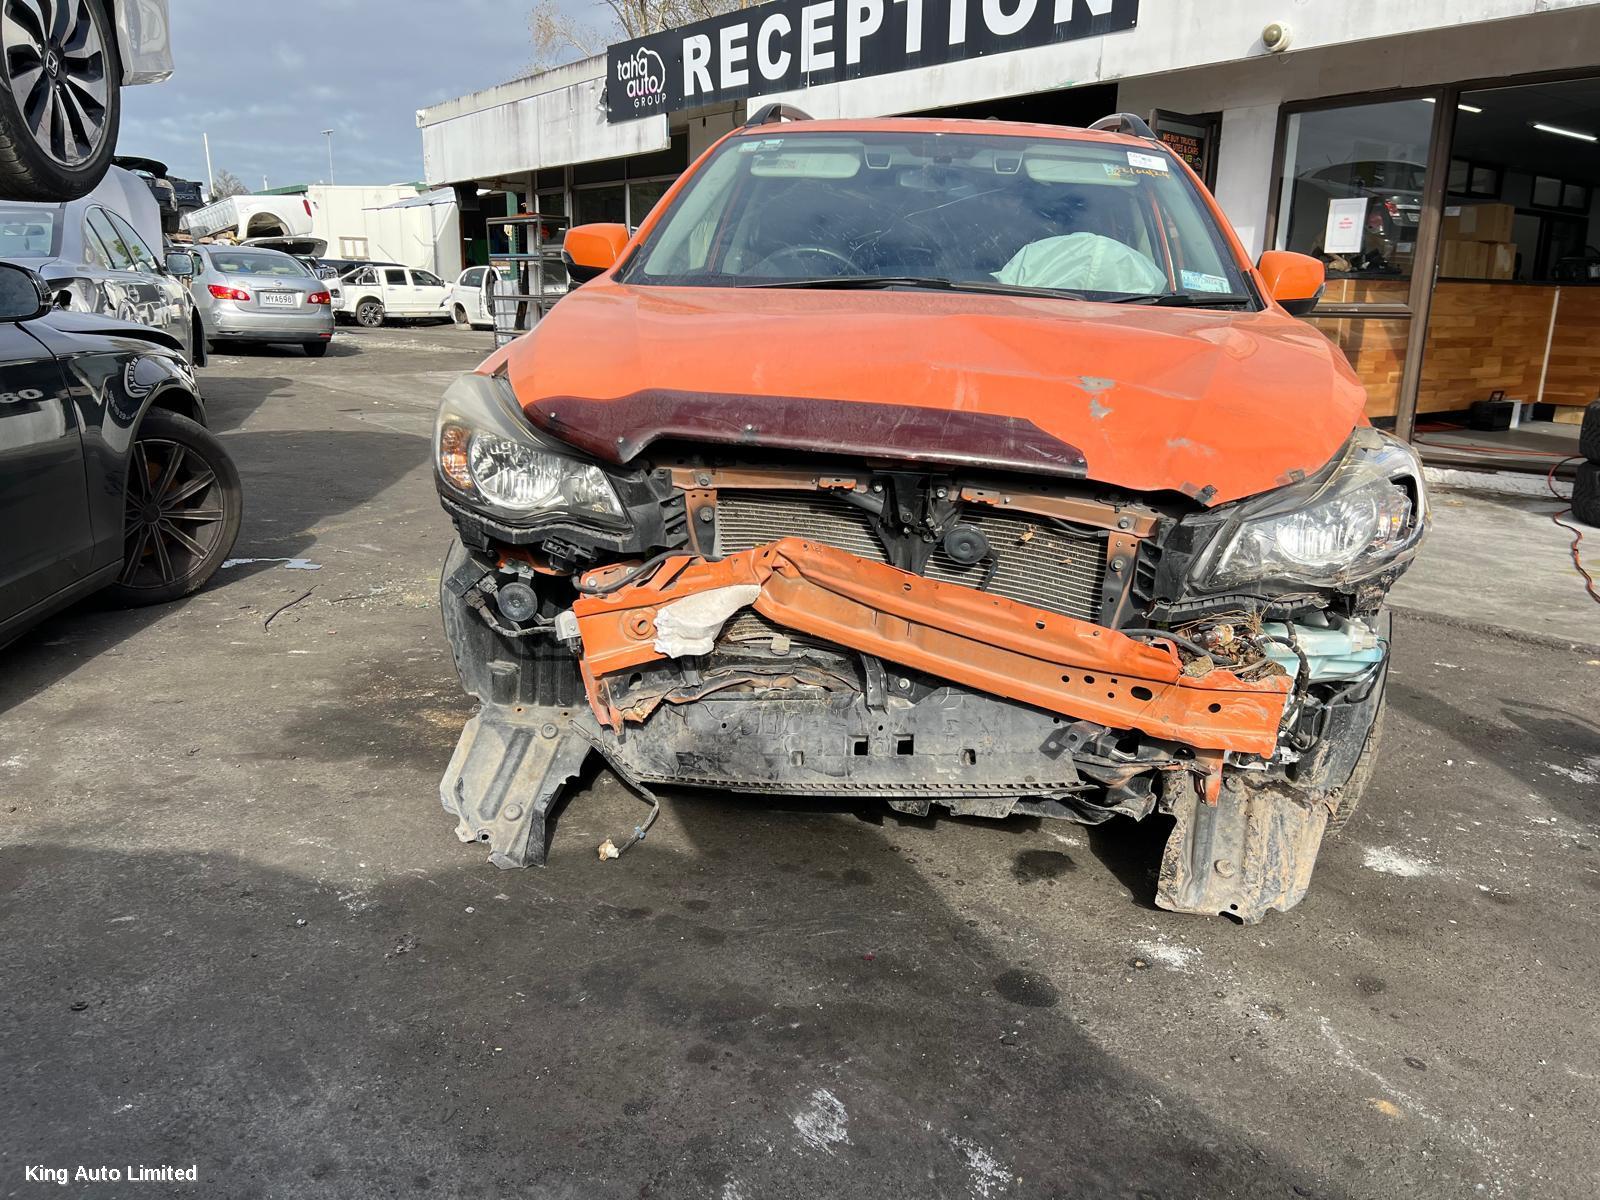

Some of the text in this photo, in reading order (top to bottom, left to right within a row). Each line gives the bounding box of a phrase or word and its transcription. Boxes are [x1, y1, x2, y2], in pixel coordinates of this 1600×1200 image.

[682, 0, 1113, 97] RECEPTI
[627, 75, 658, 98] auto
[634, 93, 667, 108] GROUP
